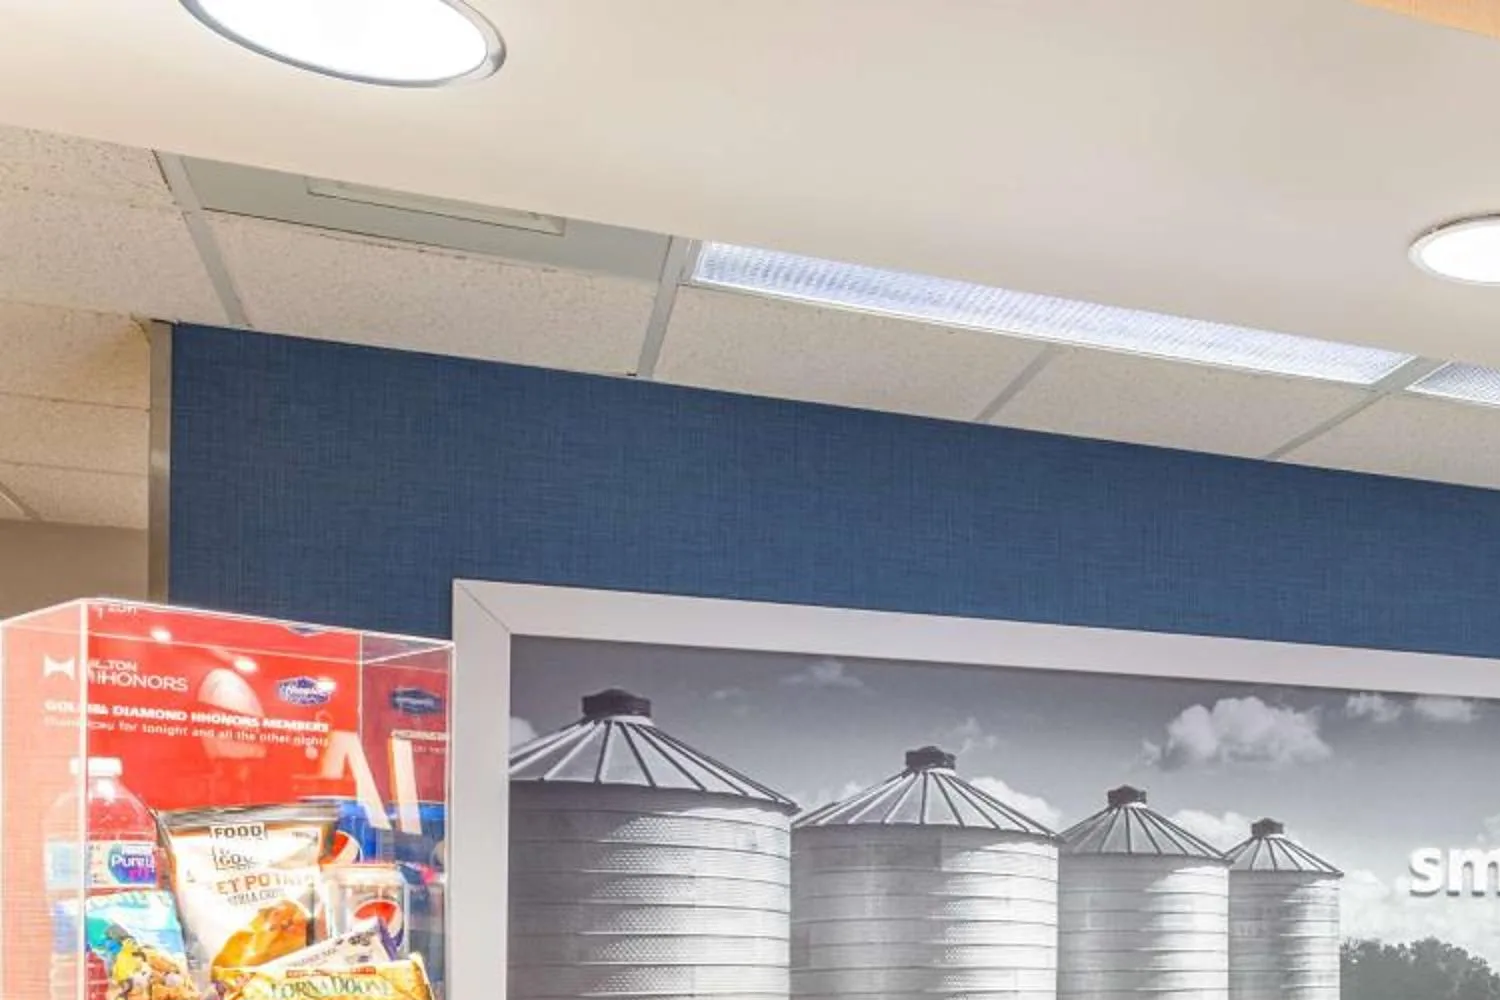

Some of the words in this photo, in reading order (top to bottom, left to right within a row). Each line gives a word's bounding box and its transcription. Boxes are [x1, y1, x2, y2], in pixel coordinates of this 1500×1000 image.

[111, 704, 188, 720] DIAMOND
[142, 723, 188, 736] tonight
[213, 825, 263, 839] FOOD
